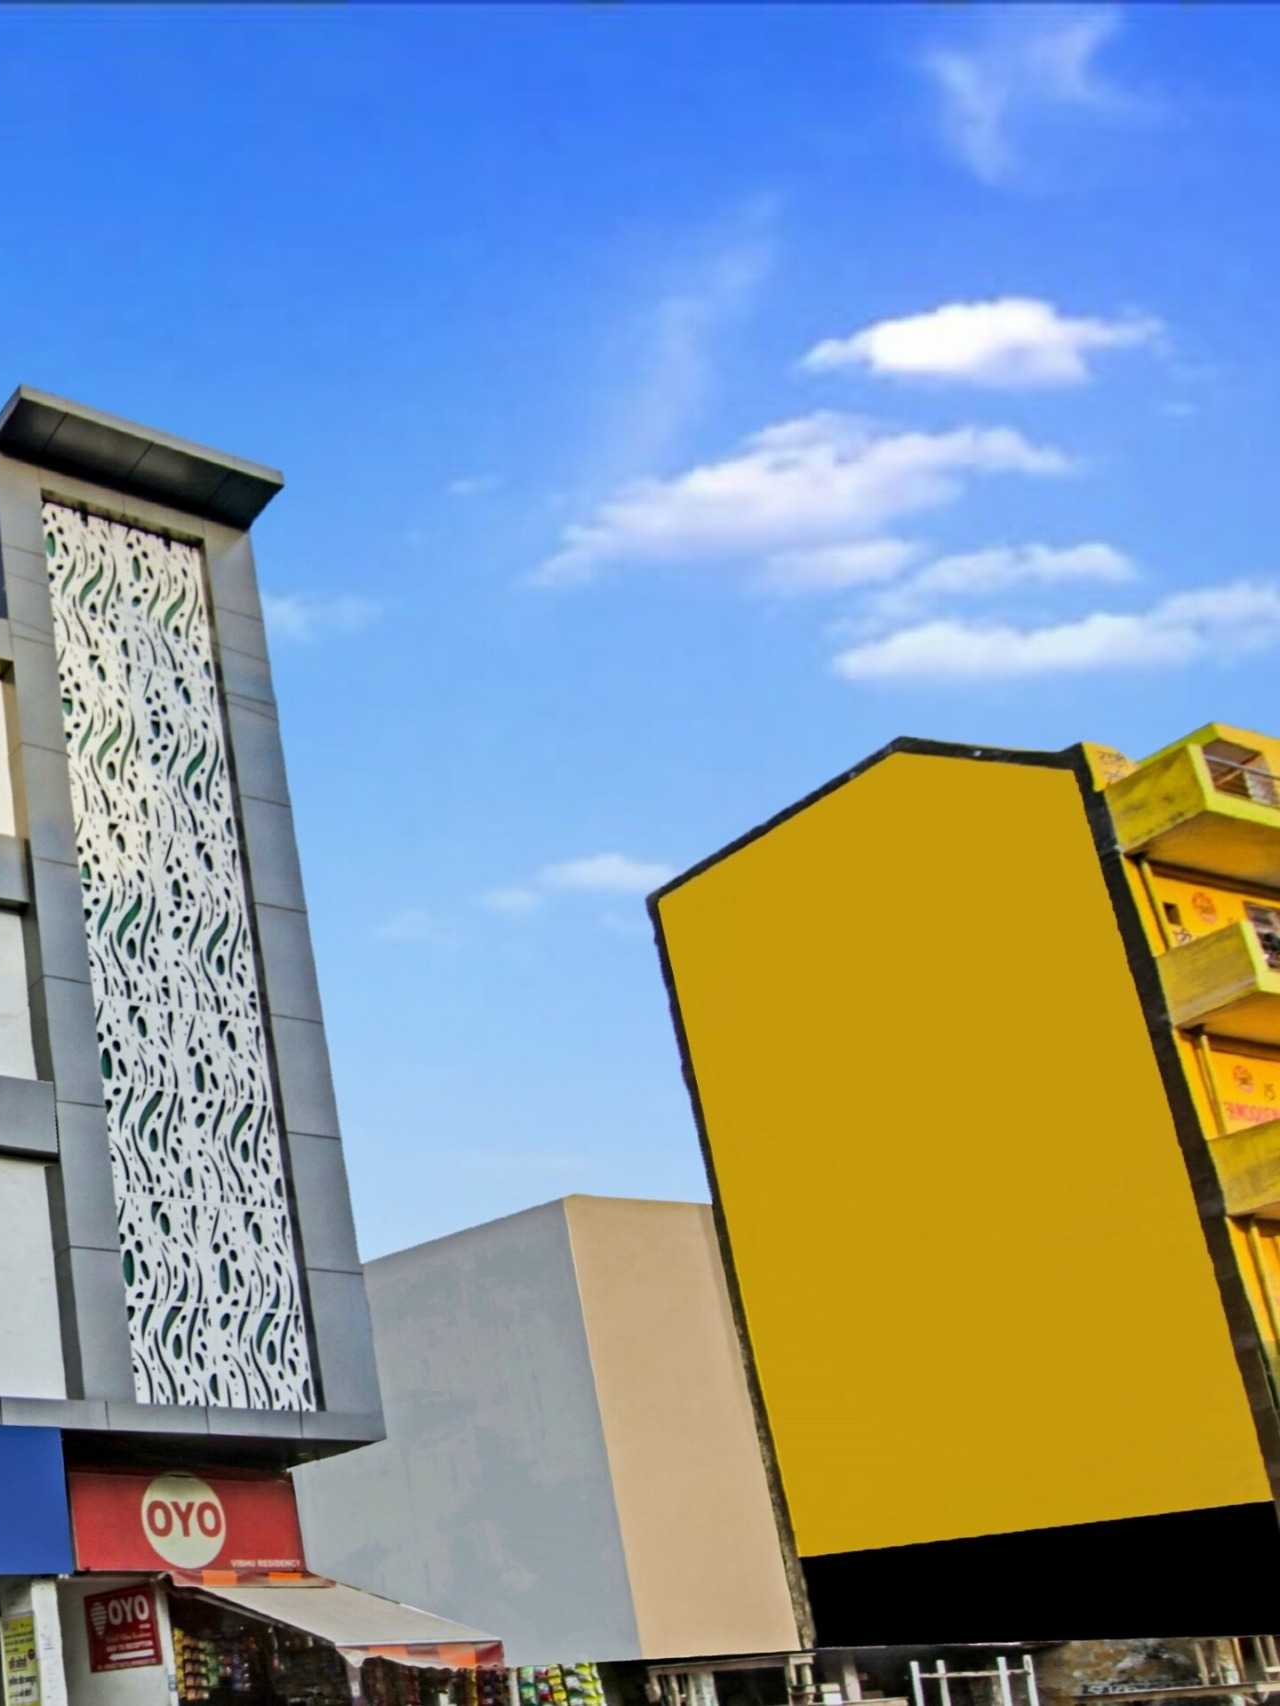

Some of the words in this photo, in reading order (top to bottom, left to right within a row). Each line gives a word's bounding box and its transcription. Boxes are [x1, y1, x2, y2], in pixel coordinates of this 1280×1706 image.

[147, 1500, 222, 1537] OYO
[257, 1559, 300, 1568] RESIDENCY
[107, 1594, 150, 1626] OYO
